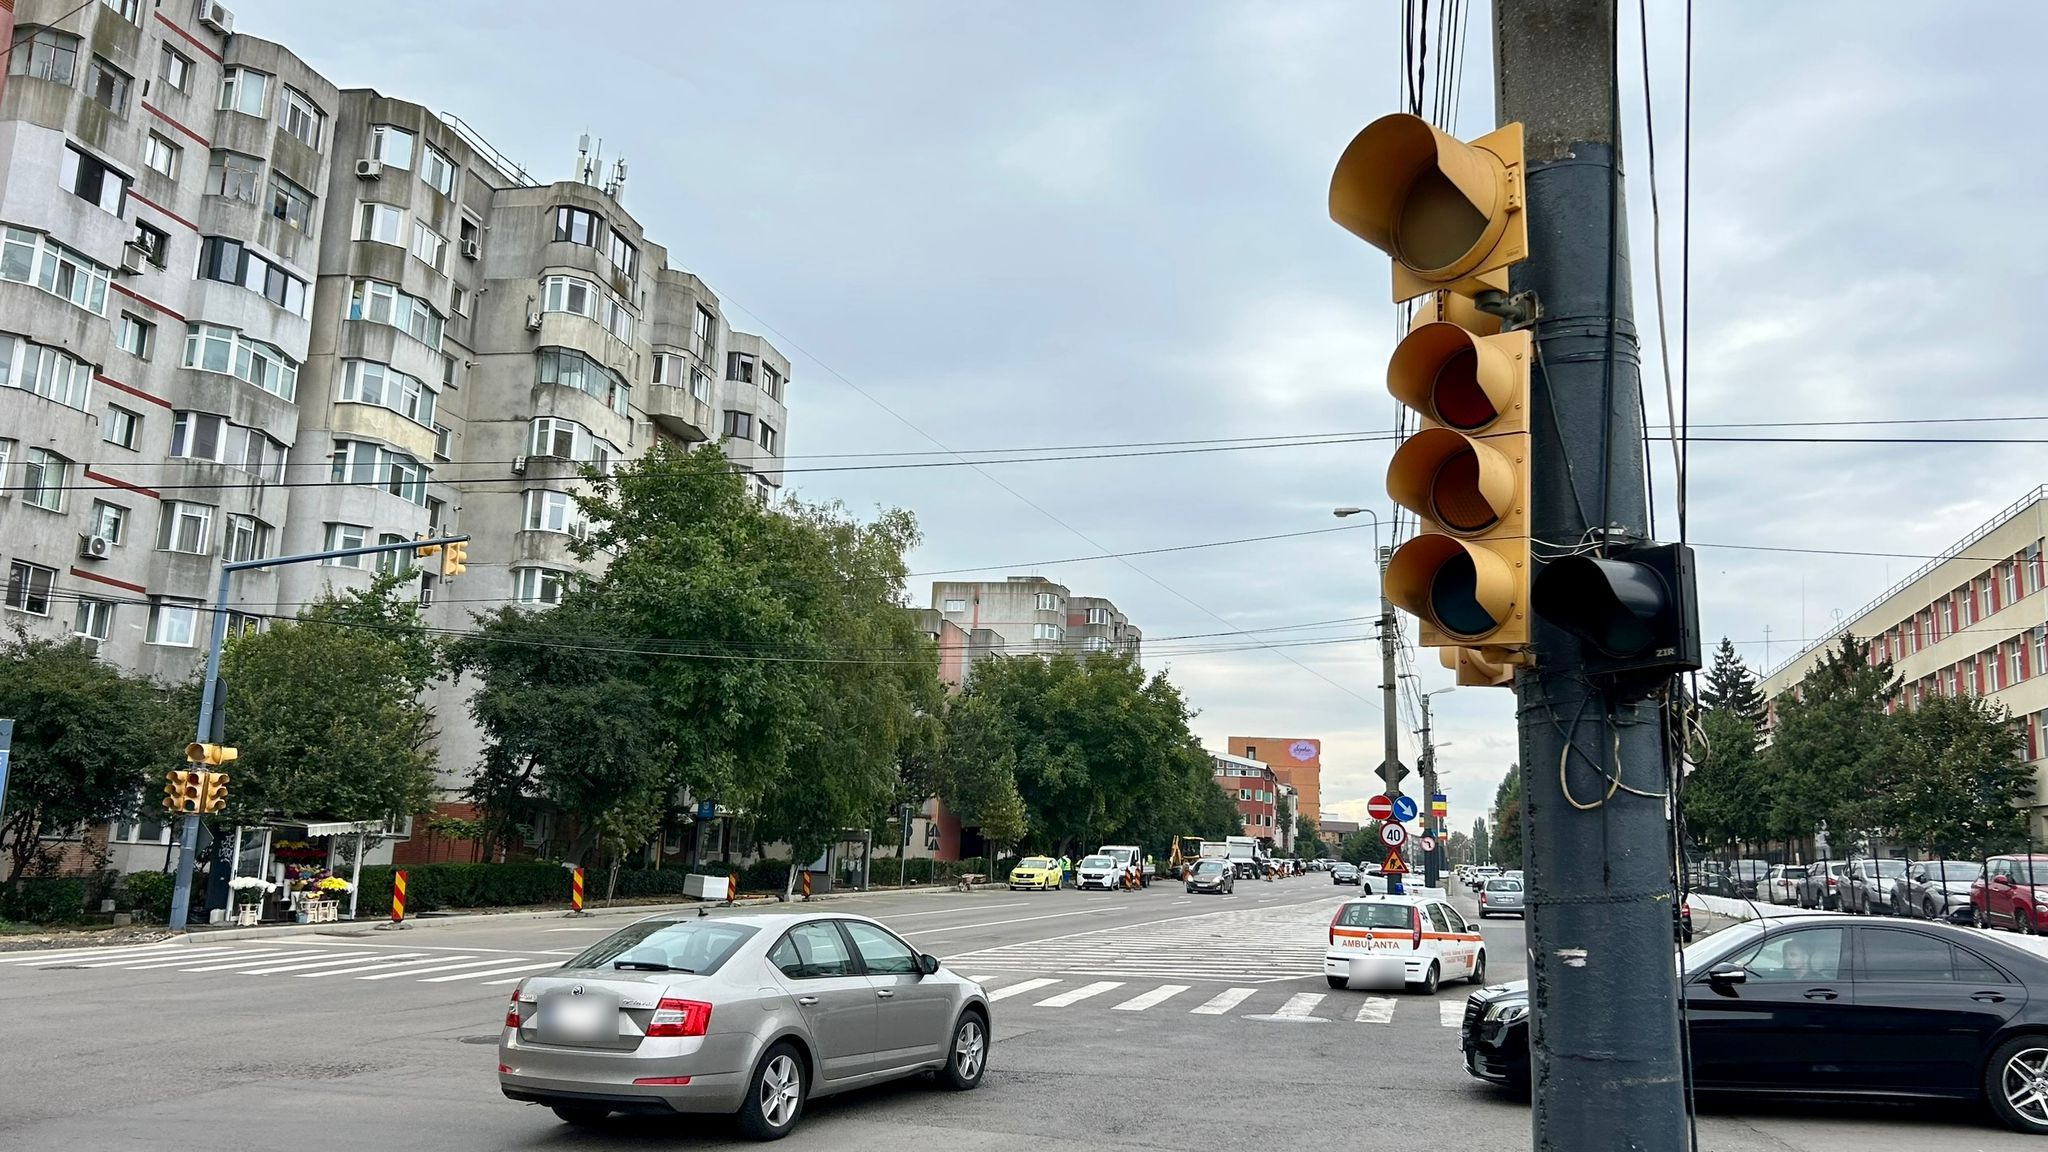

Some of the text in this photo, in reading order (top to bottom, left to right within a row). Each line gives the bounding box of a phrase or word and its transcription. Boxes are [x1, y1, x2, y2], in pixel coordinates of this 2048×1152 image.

[1656, 648, 1676, 657] ZIR
[1387, 829, 1401, 841] 40
[1342, 939, 1400, 950] AMBULANTA
